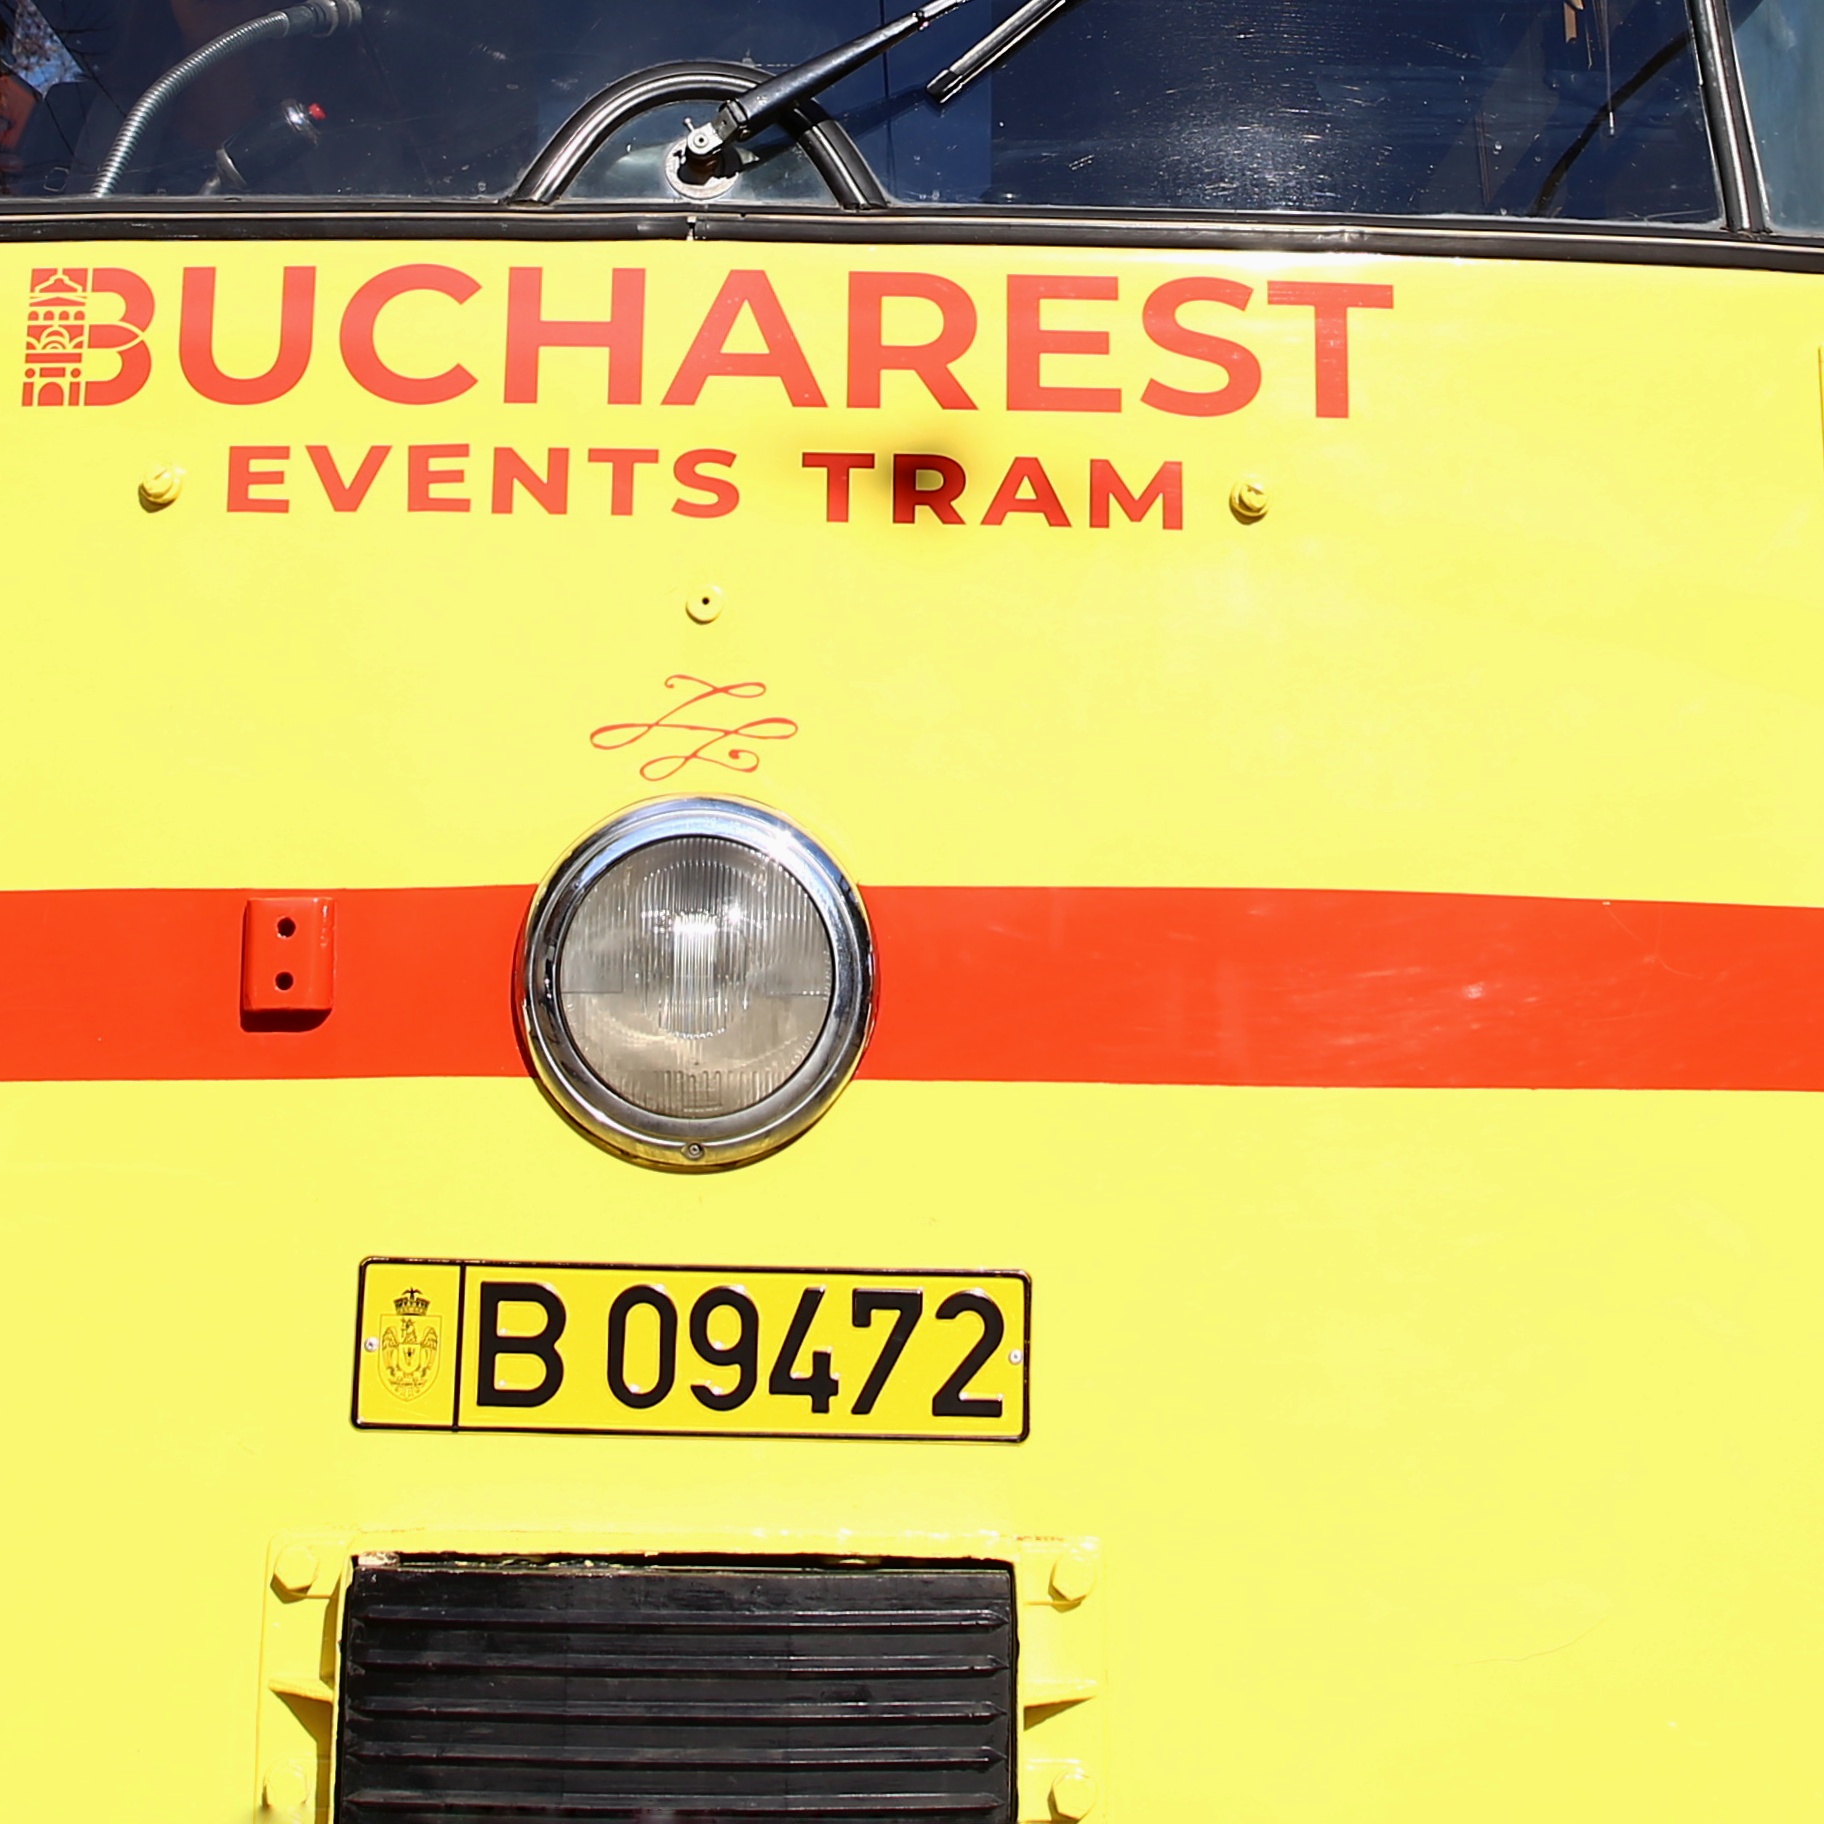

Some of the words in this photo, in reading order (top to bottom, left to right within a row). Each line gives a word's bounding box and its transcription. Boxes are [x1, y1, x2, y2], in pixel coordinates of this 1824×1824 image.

[21, 263, 1394, 420] BUCHAREST
[226, 443, 742, 519] EVENTS
[801, 451, 1183, 532] TRAM
[476, 1281, 567, 1408] B
[606, 1285, 1006, 1418] 09472
